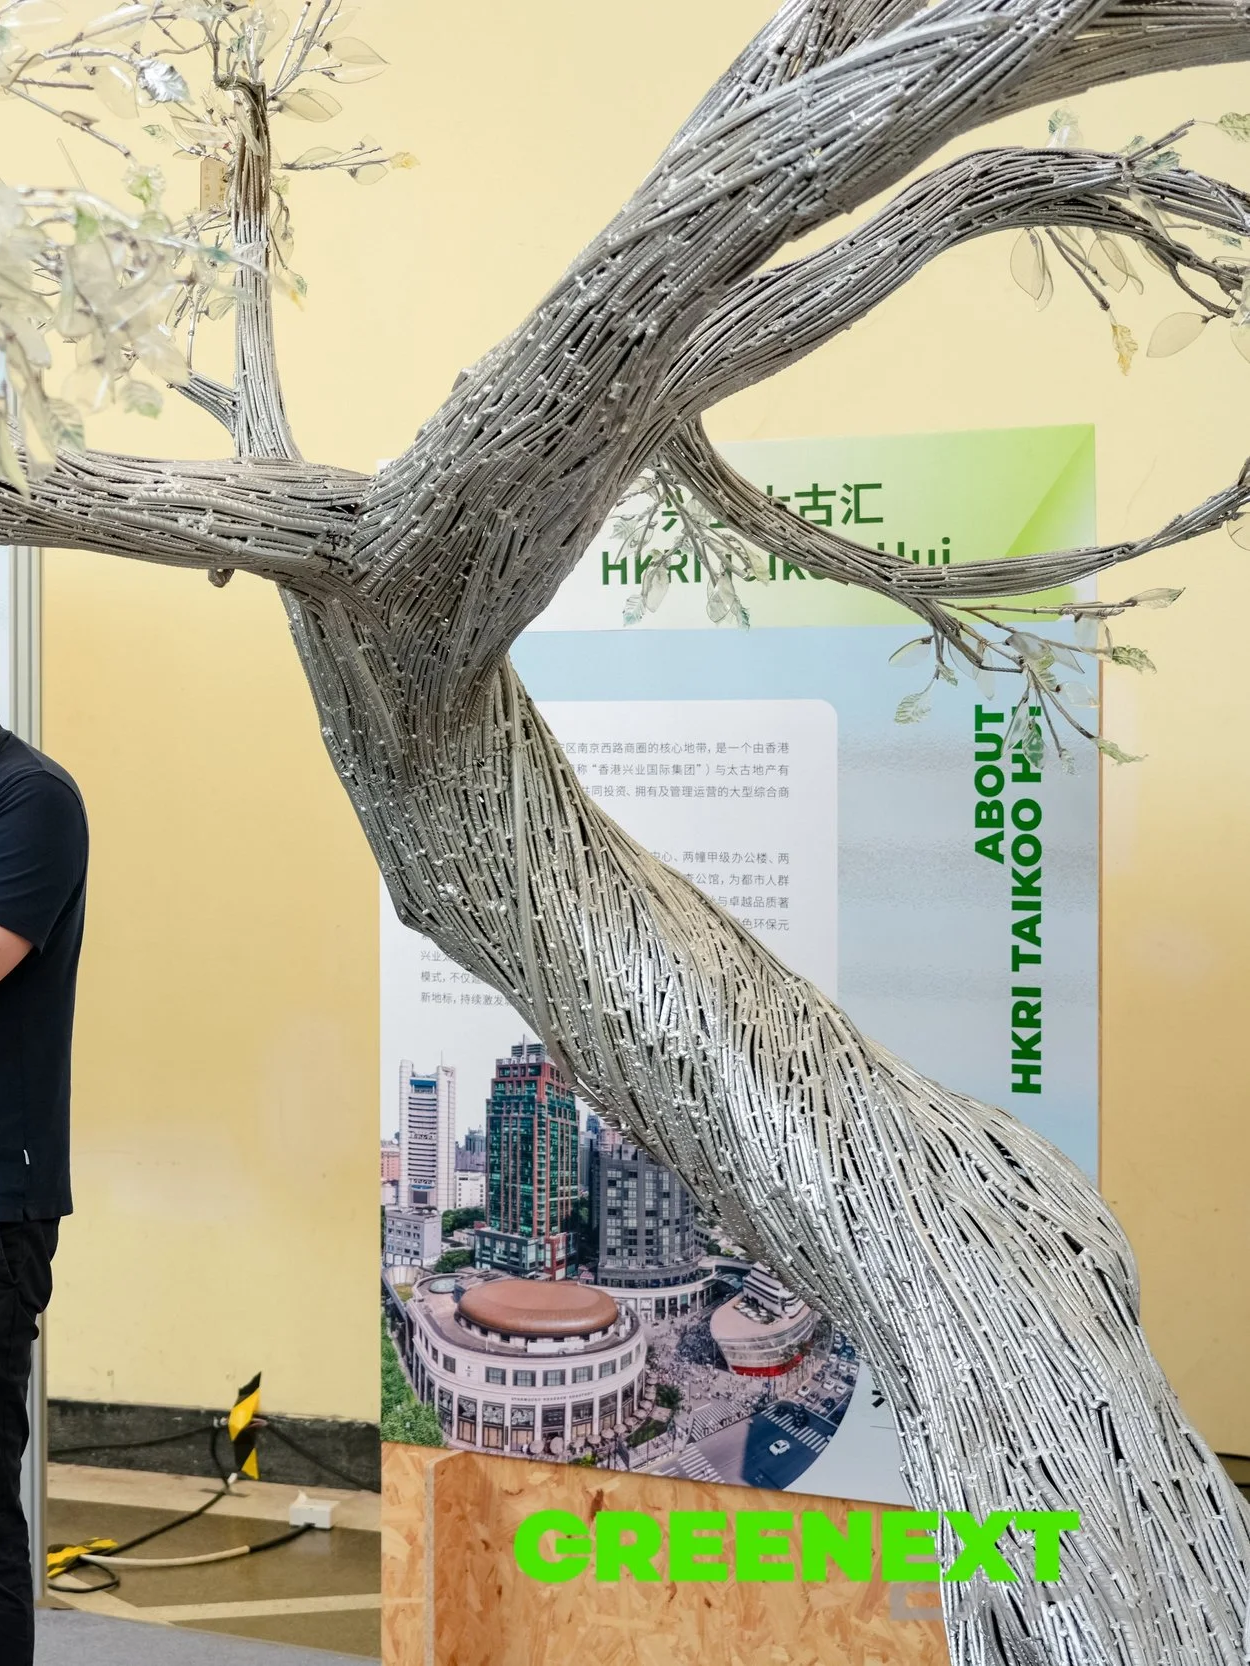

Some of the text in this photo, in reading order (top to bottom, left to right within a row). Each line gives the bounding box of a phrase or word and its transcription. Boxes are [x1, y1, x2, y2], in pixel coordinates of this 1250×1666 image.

[573, 763, 790, 777] 称“香港兴业国际集团”）与太古地产有
[974, 704, 1005, 865] ABOUT
[1011, 797, 1042, 973] TAIKOO
[710, 896, 789, 909] 与卓越品质著
[737, 918, 789, 931] 色环保元
[421, 991, 513, 1007] 新地标，持续激发
[1011, 985, 1042, 1094] HKRI
